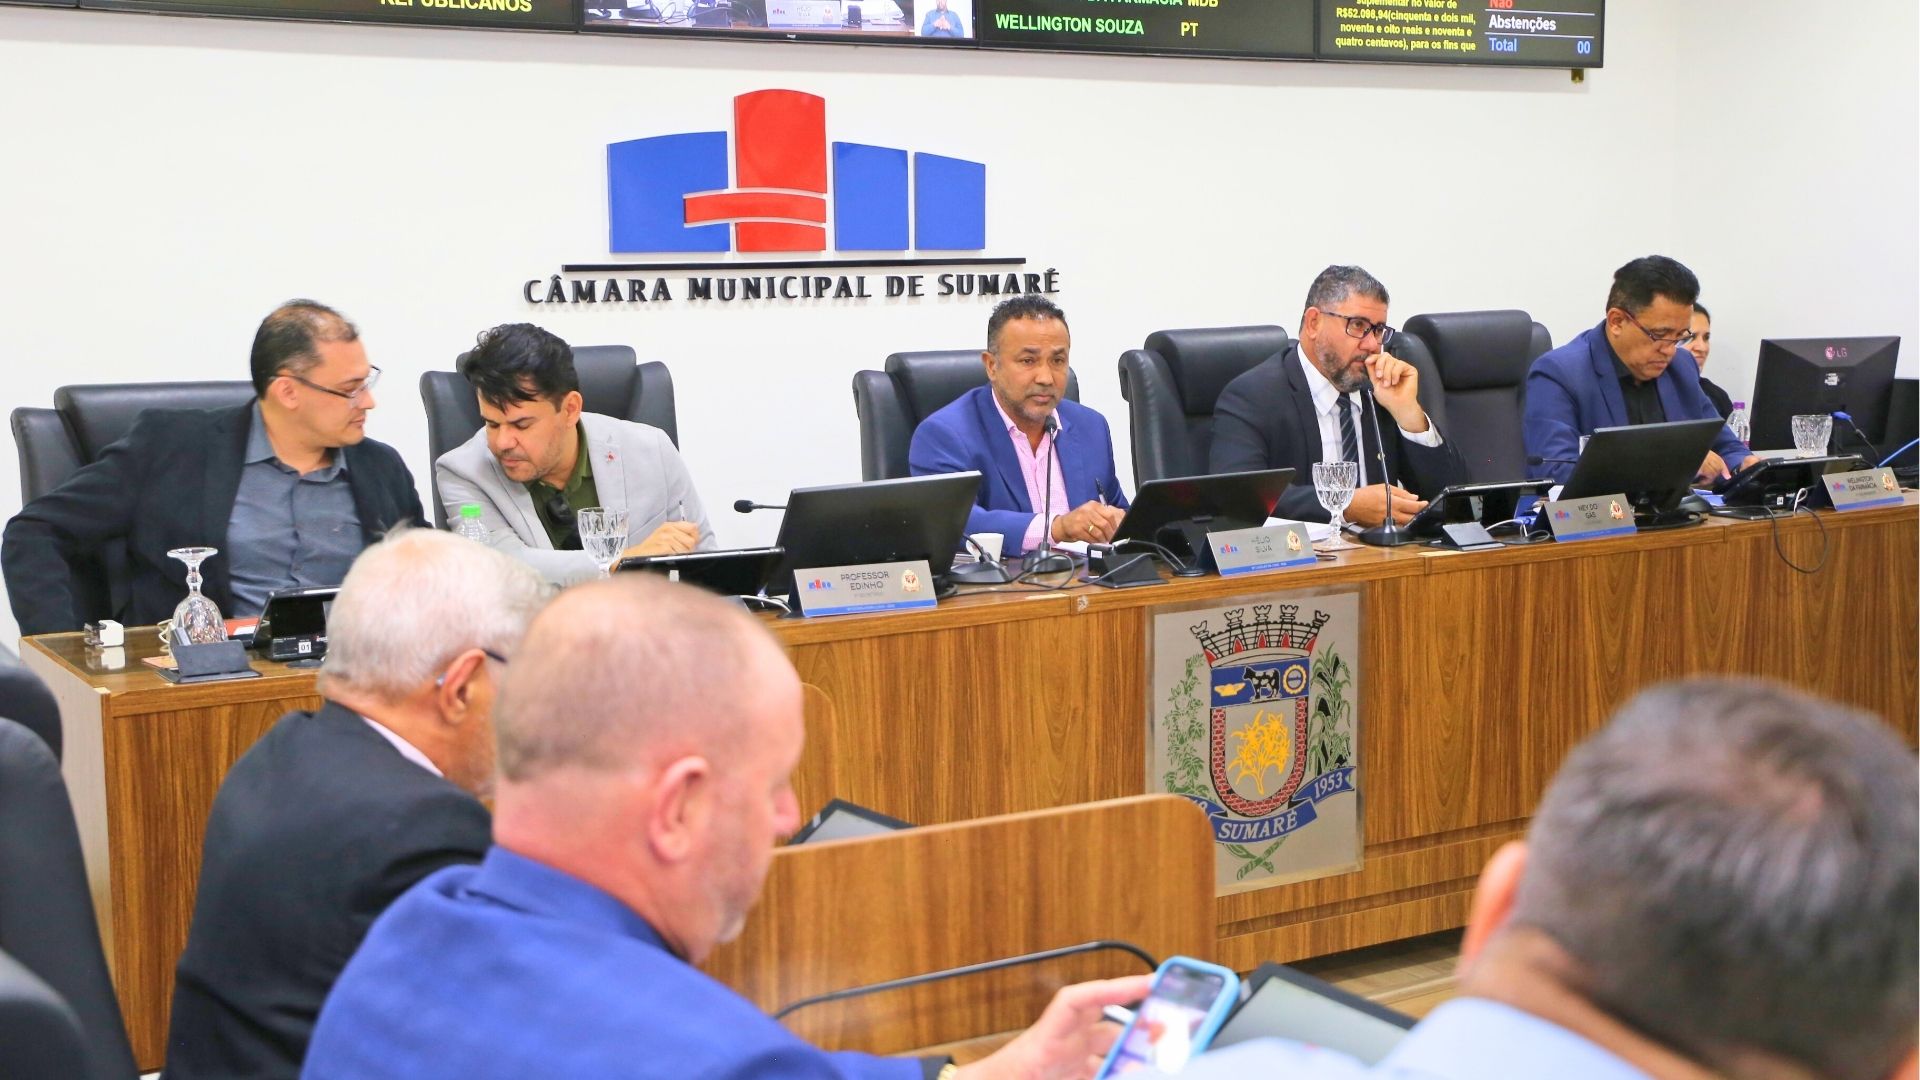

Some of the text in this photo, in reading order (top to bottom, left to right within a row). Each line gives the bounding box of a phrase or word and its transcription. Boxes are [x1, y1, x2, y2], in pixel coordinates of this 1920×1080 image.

[1446, 0, 1458, 9] de
[995, 13, 1145, 35] WELLINGTON SOUZA
[1433, 14, 1440, 22] e
[1441, 12, 1459, 23] dois
[1488, 14, 1557, 33] Abstenções
[1180, 21, 1199, 37] PT
[1340, 23, 1473, 37] noventa e oito reais e noventa e
[1335, 37, 1476, 52] quatro centavos), para os fins que
[1488, 37, 1518, 52] Total
[1577, 40, 1591, 54] 00
[523, 267, 1061, 304] CÂMARA MUNICIPAL DE SUMARÉ
[840, 571, 889, 581] PROFESSOR
[850, 581, 884, 591] EDINHO
[1314, 771, 1344, 800] 1953
[1218, 810, 1299, 840] SUMARÉ
